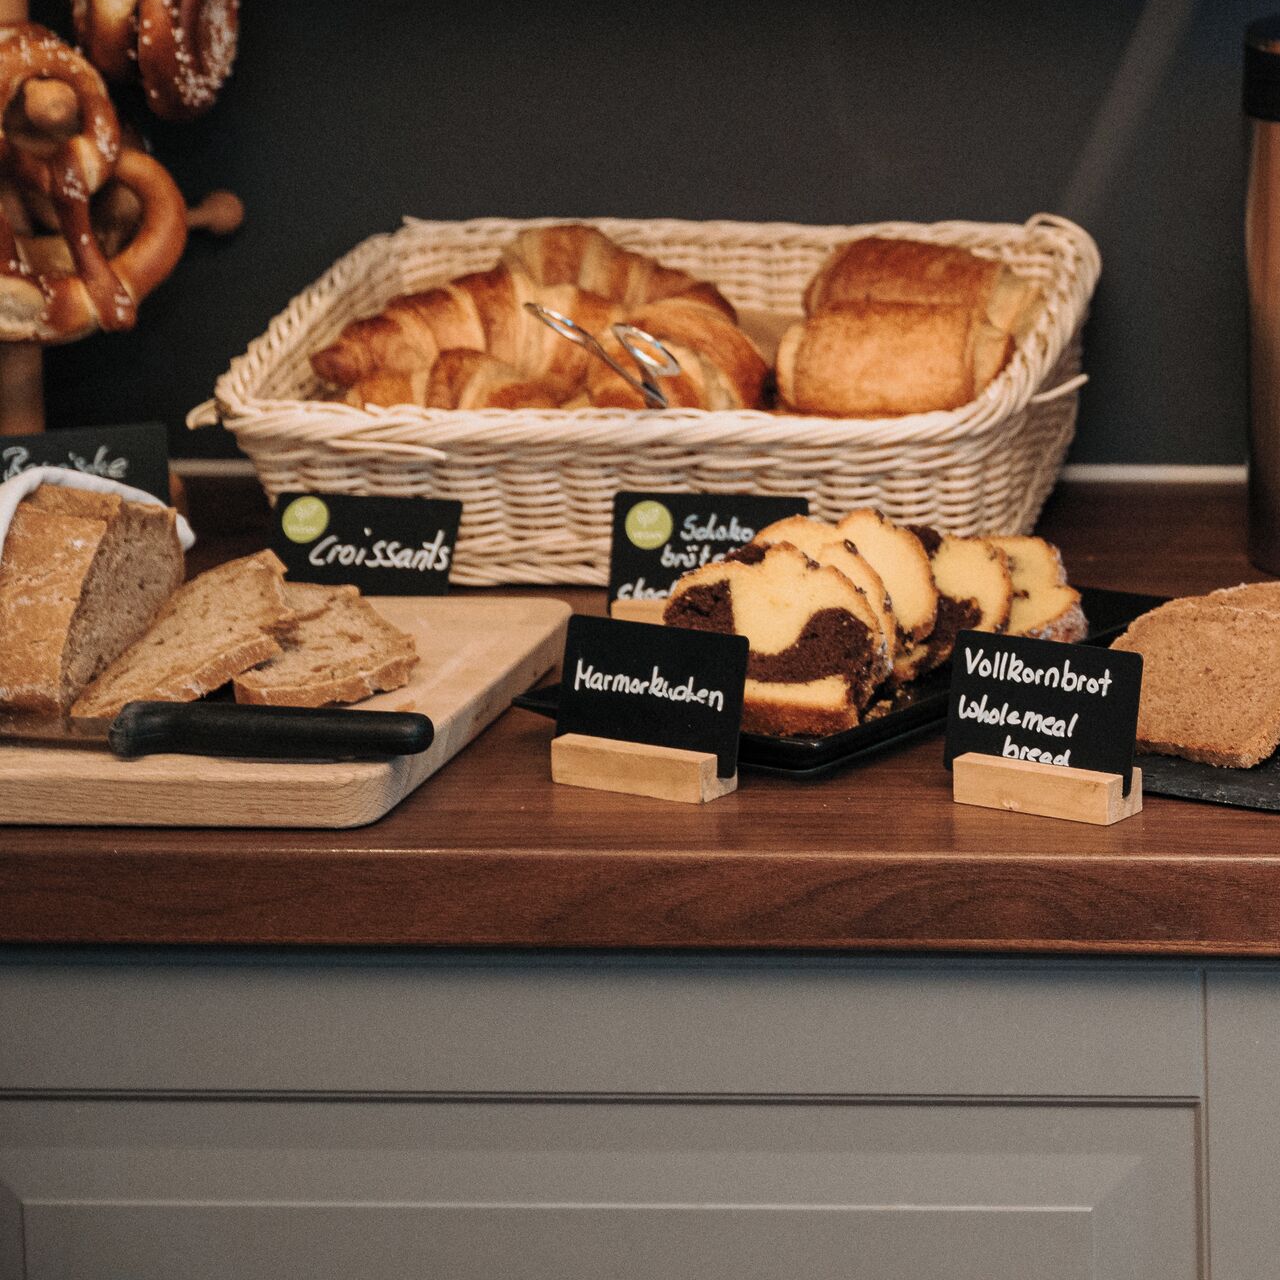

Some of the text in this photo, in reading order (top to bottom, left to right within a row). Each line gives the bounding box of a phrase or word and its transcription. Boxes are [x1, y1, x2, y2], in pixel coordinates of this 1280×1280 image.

[309, 527, 450, 571] Croissants
[680, 512, 755, 542] Schoko
[574, 658, 724, 712] Marmorkuchen
[965, 647, 1112, 697] Vollkornbrot
[1003, 735, 1071, 766] bread
